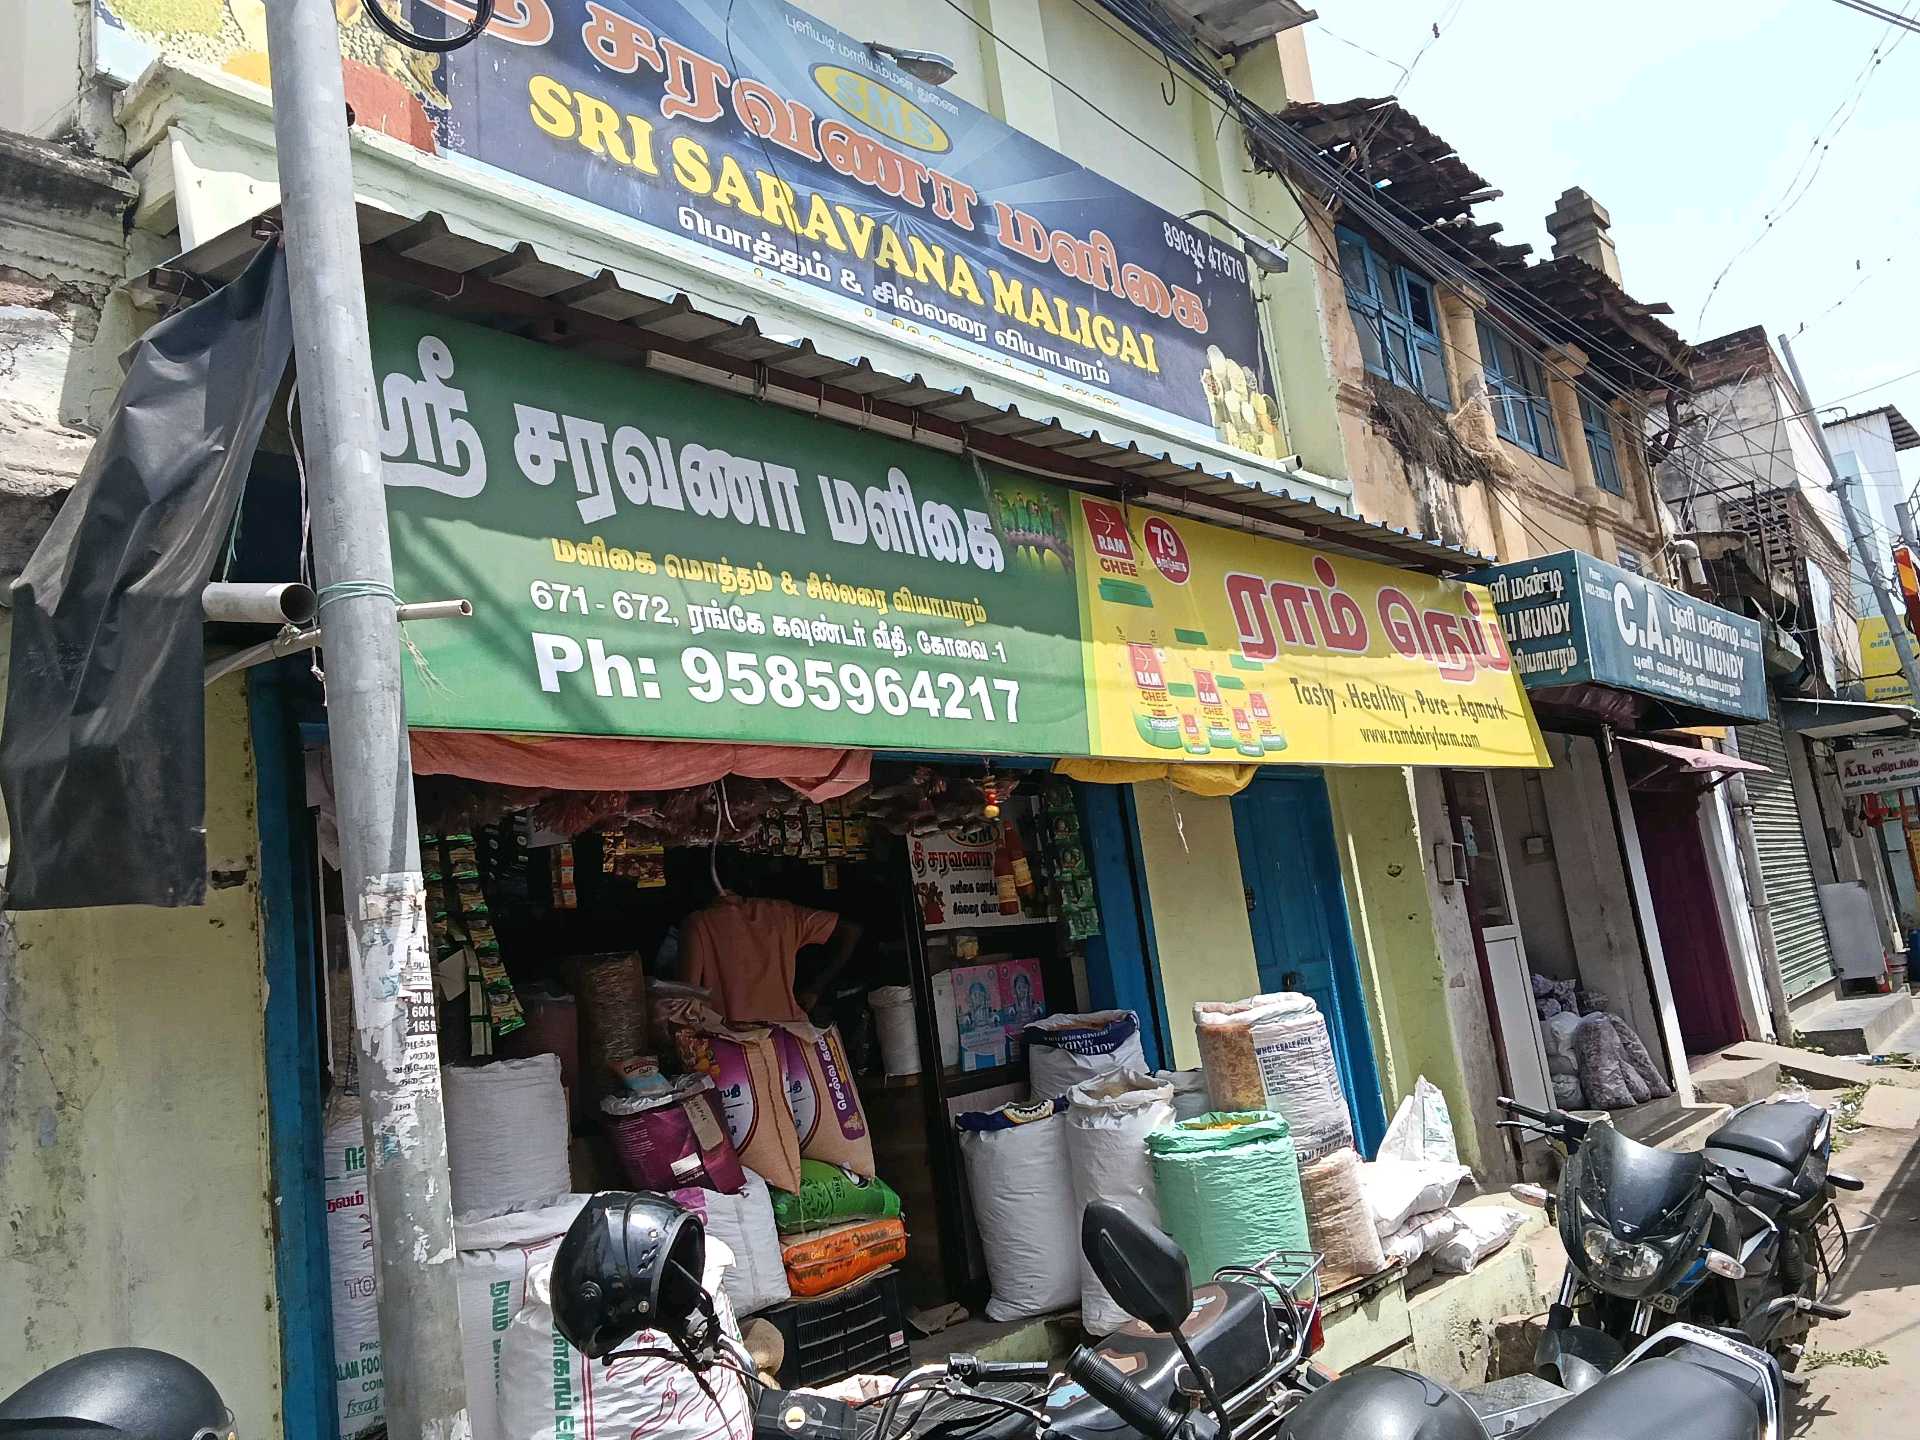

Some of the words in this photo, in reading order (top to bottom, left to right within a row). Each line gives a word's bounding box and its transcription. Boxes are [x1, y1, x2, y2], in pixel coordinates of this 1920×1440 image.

[581, 0, 977, 232] சரவணா
[995, 201, 1208, 334] மளிகை
[528, 74, 660, 177] SRI
[671, 136, 984, 305] SARAVANA
[987, 268, 1160, 373] MALIGAI
[1207, 244, 1246, 284] 47870
[677, 205, 832, 282] மொத்தம்
[840, 268, 864, 296] &
[871, 281, 988, 343] சில்லரை
[994, 328, 1111, 386] வியாபாரம்
[513, 402, 806, 535] சரவணா
[817, 466, 1006, 574] மளிகை
[1096, 534, 1128, 555] RAM
[1150, 525, 1178, 557] 79
[551, 535, 657, 576] மளிகை
[664, 553, 774, 597] மொத்தம்
[780, 570, 801, 597] &
[891, 585, 989, 628] வியாபாரம்
[1100, 557, 1138, 578] GHEE
[529, 579, 590, 616] 671
[611, 589, 681, 629] 672,
[686, 598, 766, 635] ரங்கே
[771, 613, 868, 648] கவுண்டர்
[915, 629, 989, 662] கோவை
[1224, 556, 1369, 663] ராம்
[1377, 585, 1511, 683] நெய்
[1502, 613, 1517, 642] LI
[1518, 602, 1571, 640] MUNDY
[1613, 581, 1673, 657] C.A.
[1668, 604, 1697, 633] புளி
[1697, 614, 1740, 652] மண்டி
[531, 631, 661, 700] Ph:
[680, 646, 1020, 724] 9585964217
[1135, 671, 1162, 687] RAM
[1633, 655, 1655, 671] புளி
[1671, 634, 1703, 669] PULI
[1703, 645, 1744, 681] MUNDY
[1141, 690, 1168, 702] GHEE
[1199, 691, 1221, 705] RAM
[1289, 677, 1337, 715] Tasty
[1346, 682, 1408, 719] Healthy
[1414, 689, 1450, 716] Pure
[1457, 693, 1508, 724] Agmark
